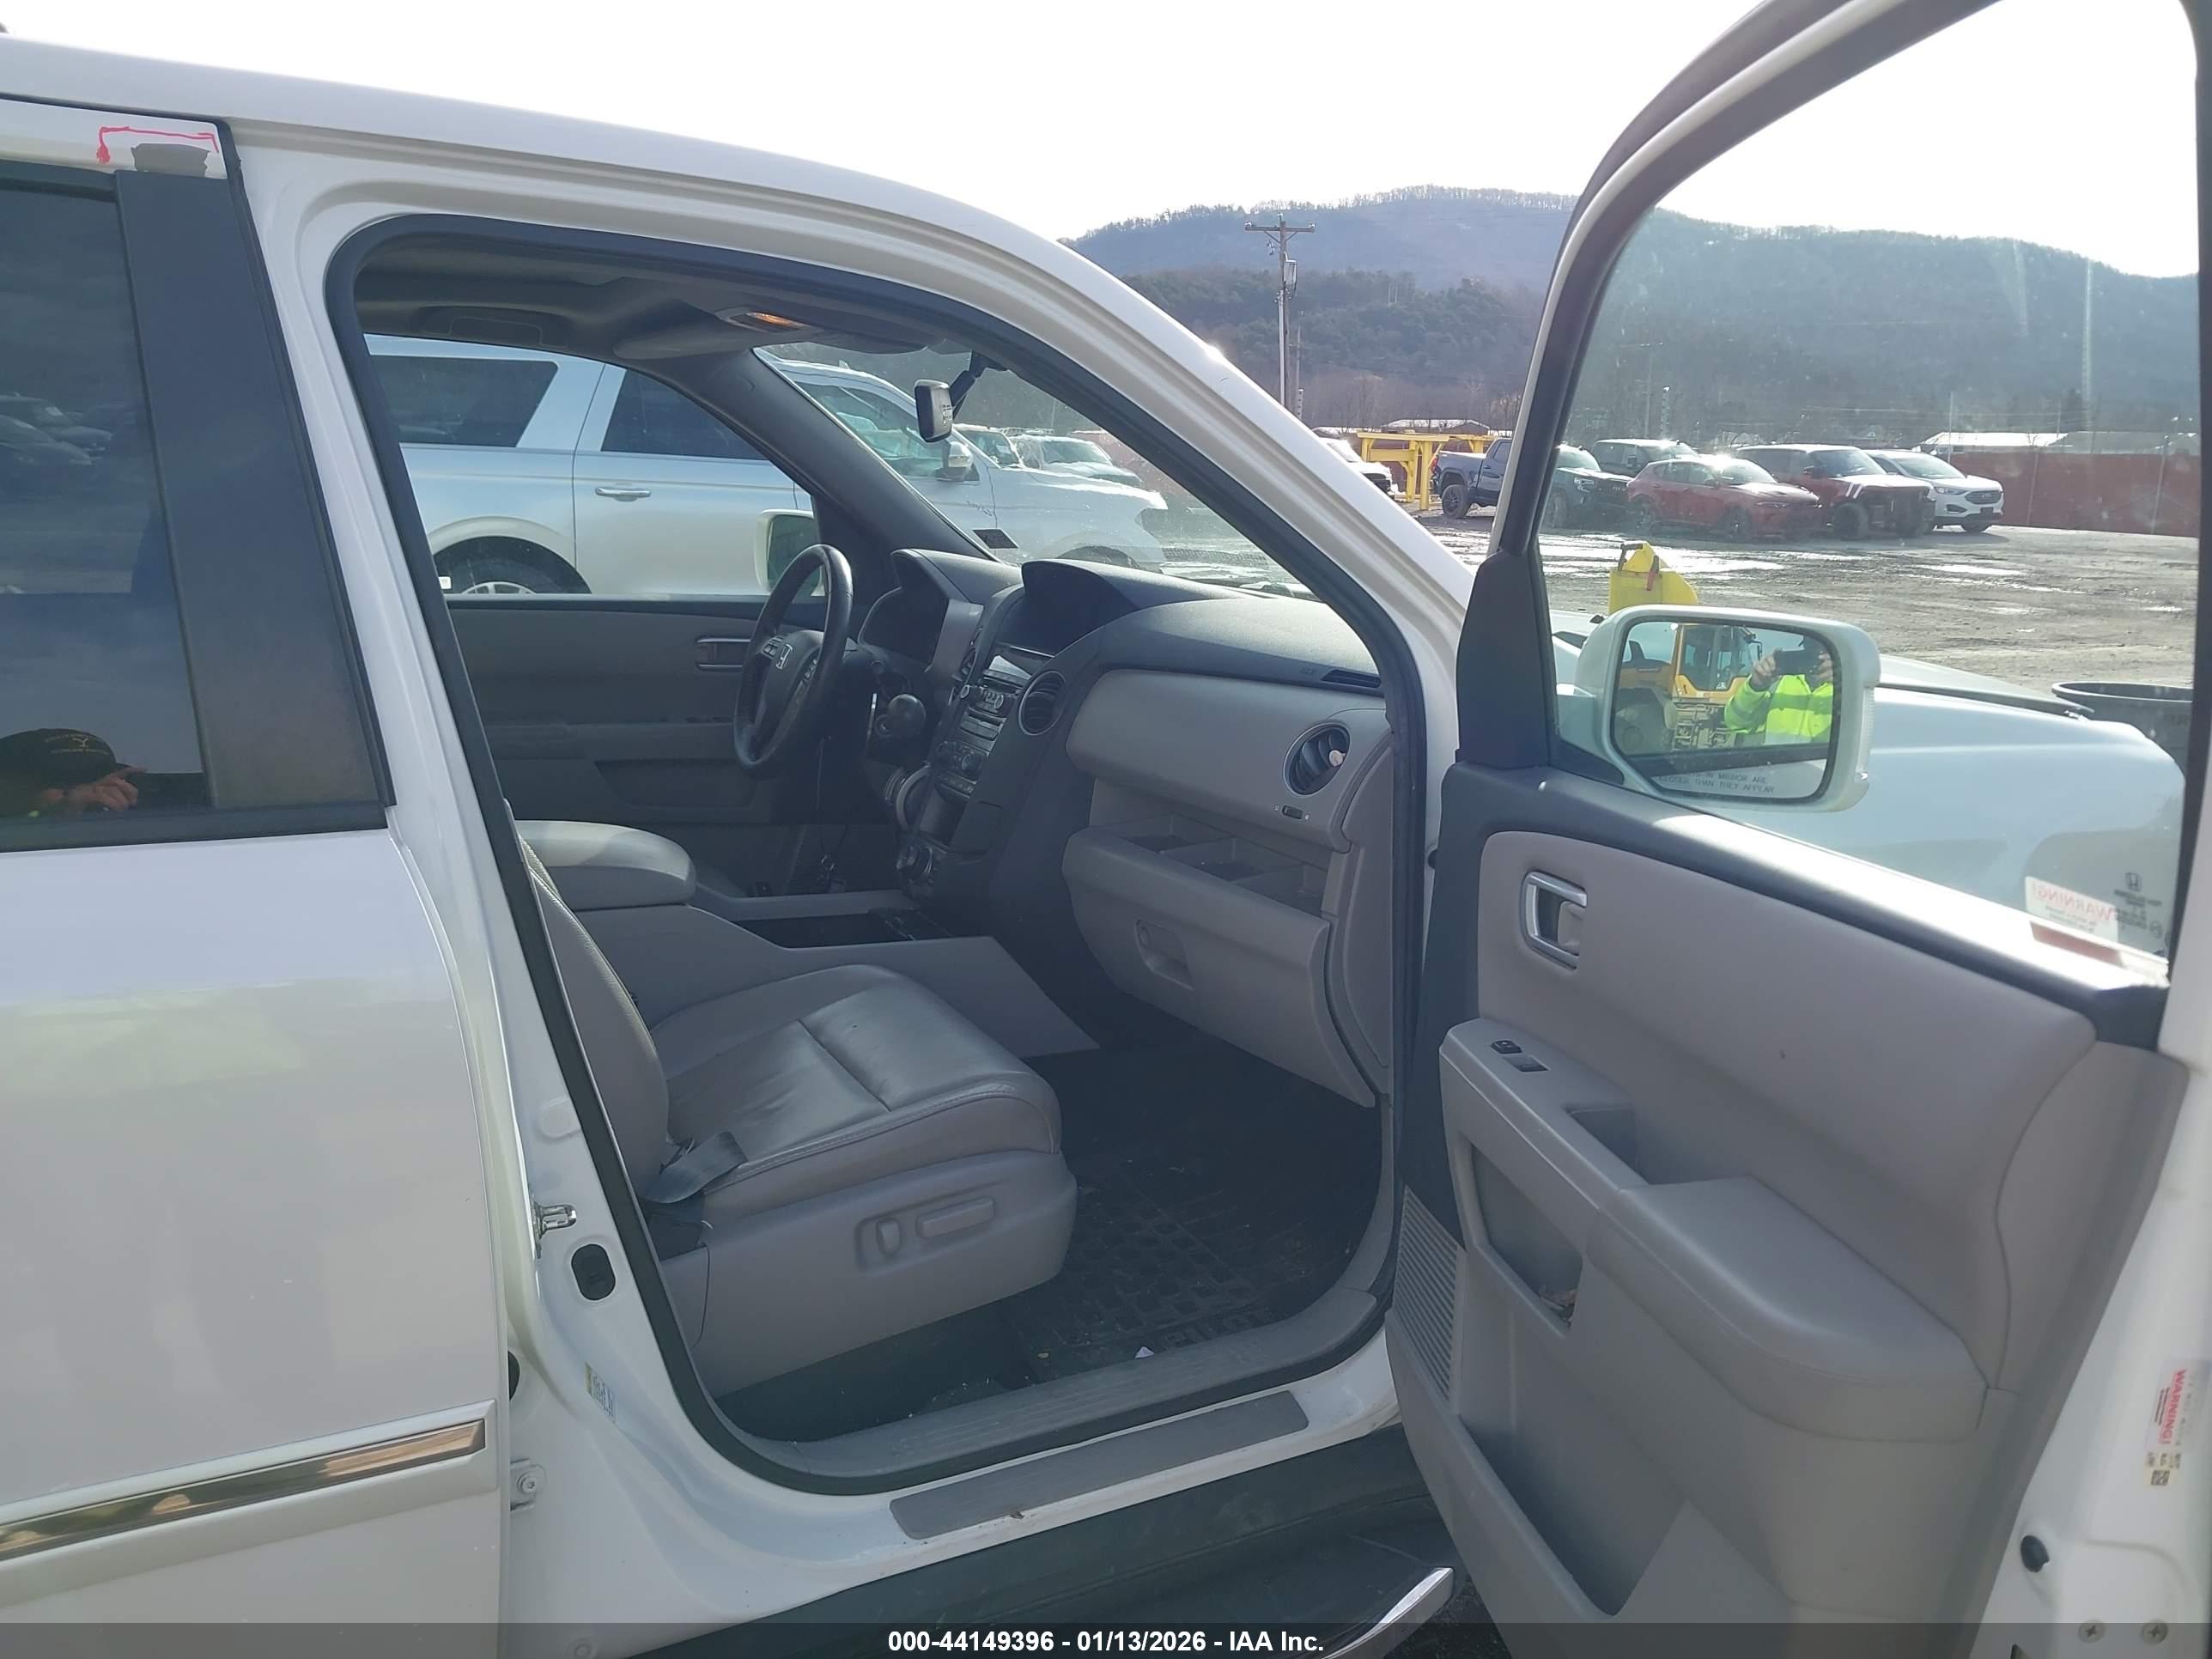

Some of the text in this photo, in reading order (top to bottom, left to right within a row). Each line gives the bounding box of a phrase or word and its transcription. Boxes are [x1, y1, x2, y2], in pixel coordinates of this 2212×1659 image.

[1718, 773, 1748, 782] MIRROR
[1695, 779, 1715, 787] THAN
[1719, 781, 1739, 790] THEY
[1742, 783, 1775, 793] APPEAR
[2160, 1369, 2186, 1444] WARNING!
